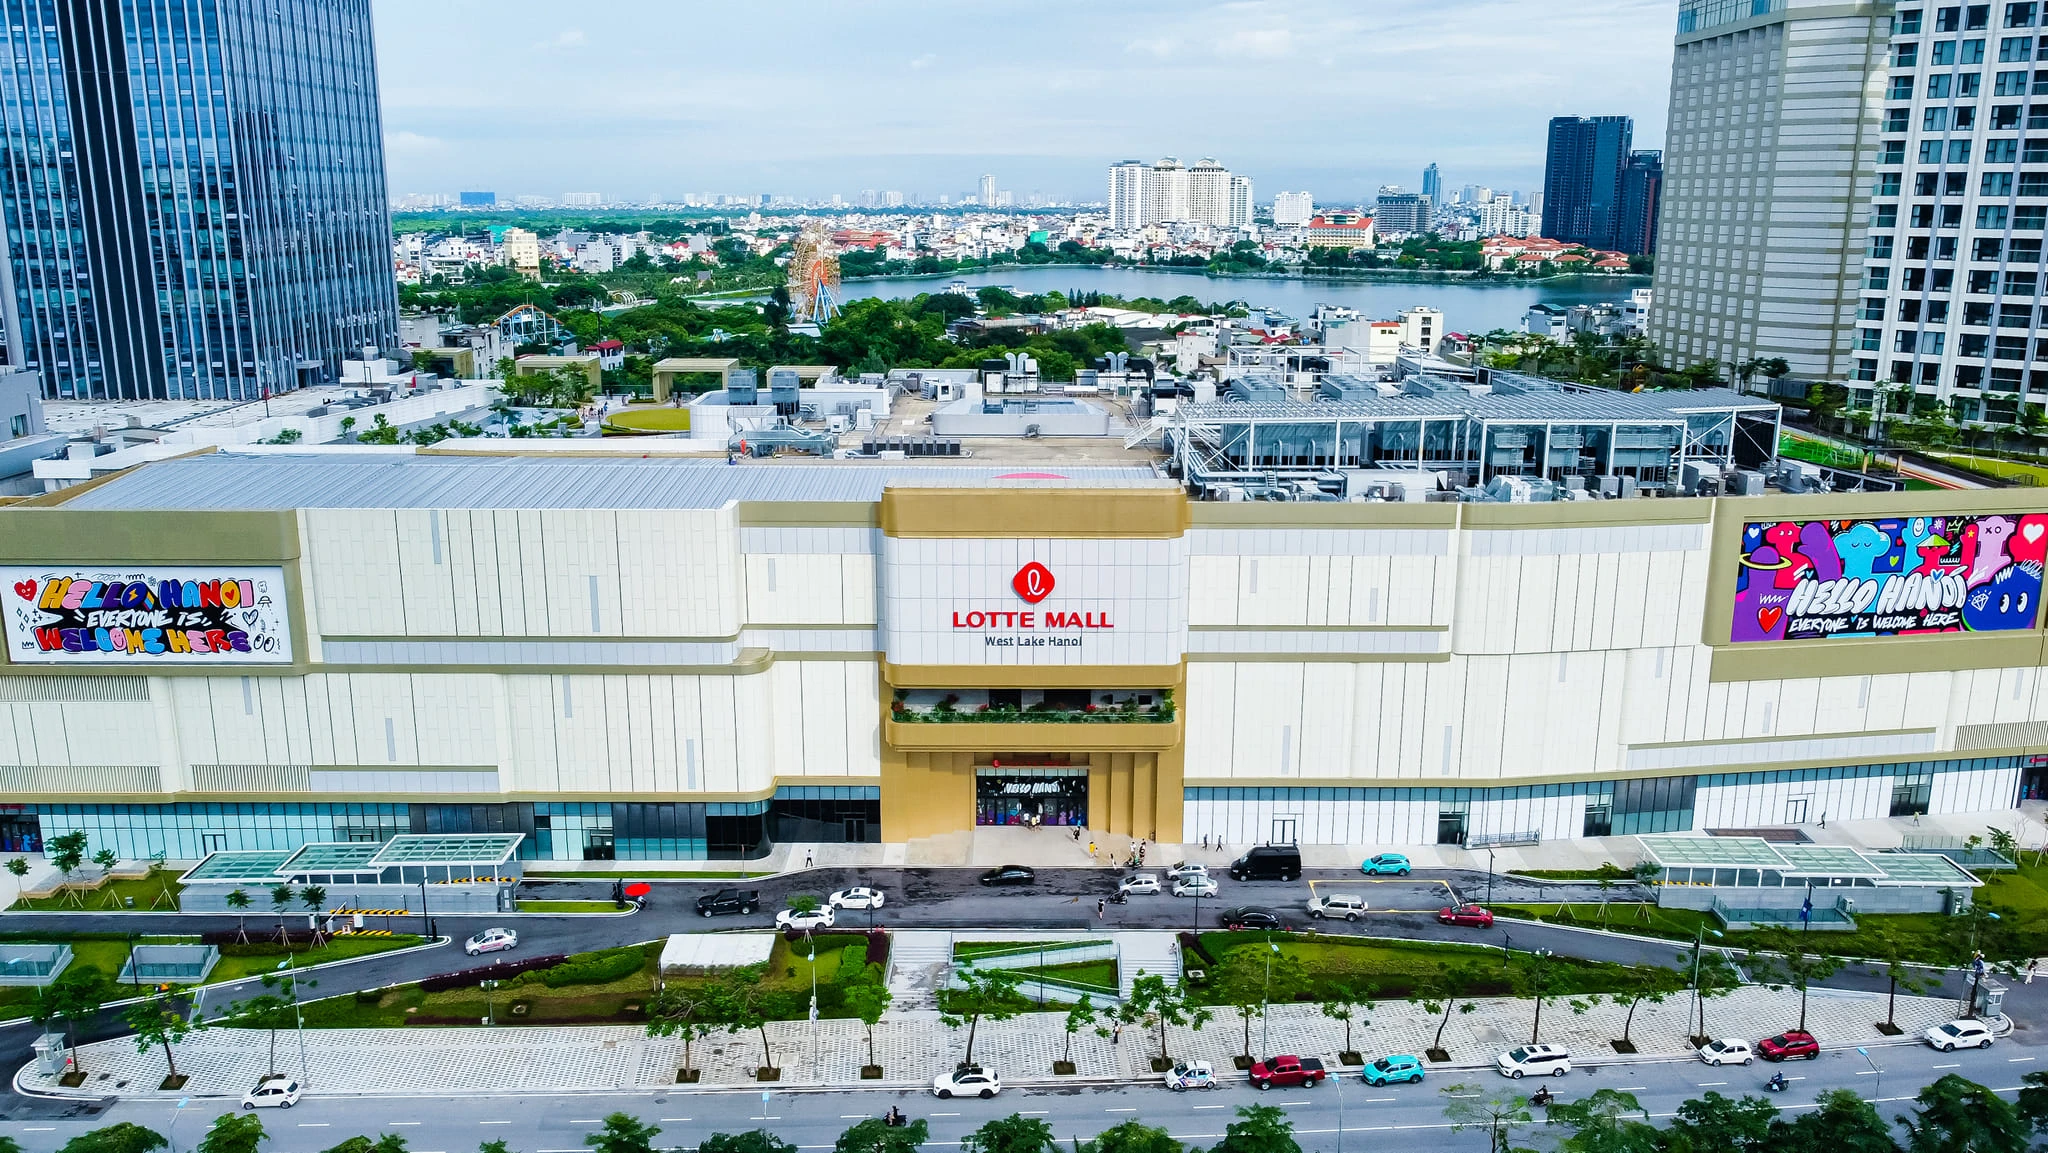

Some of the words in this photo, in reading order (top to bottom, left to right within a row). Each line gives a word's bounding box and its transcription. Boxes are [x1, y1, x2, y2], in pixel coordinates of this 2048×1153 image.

[39, 576, 151, 610] HELLO
[158, 578, 254, 610] HANOI
[1786, 578, 1879, 616] HELLO
[1877, 573, 1967, 614] HANOI
[87, 609, 173, 628] EVERYONE
[177, 611, 204, 627] IS
[953, 611, 1035, 628] LOTTE
[1045, 611, 1114, 628] MALL
[1788, 616, 1849, 633] EVERYONE
[1856, 617, 1868, 631] IS
[1872, 614, 1917, 630] WELCOME
[1922, 611, 1960, 626] HERE
[34, 627, 165, 655] WELCOME
[166, 628, 252, 654] HERE
[985, 636, 1014, 647] West
[1018, 636, 1045, 647] Lake
[1048, 636, 1082, 647] Hanoi
